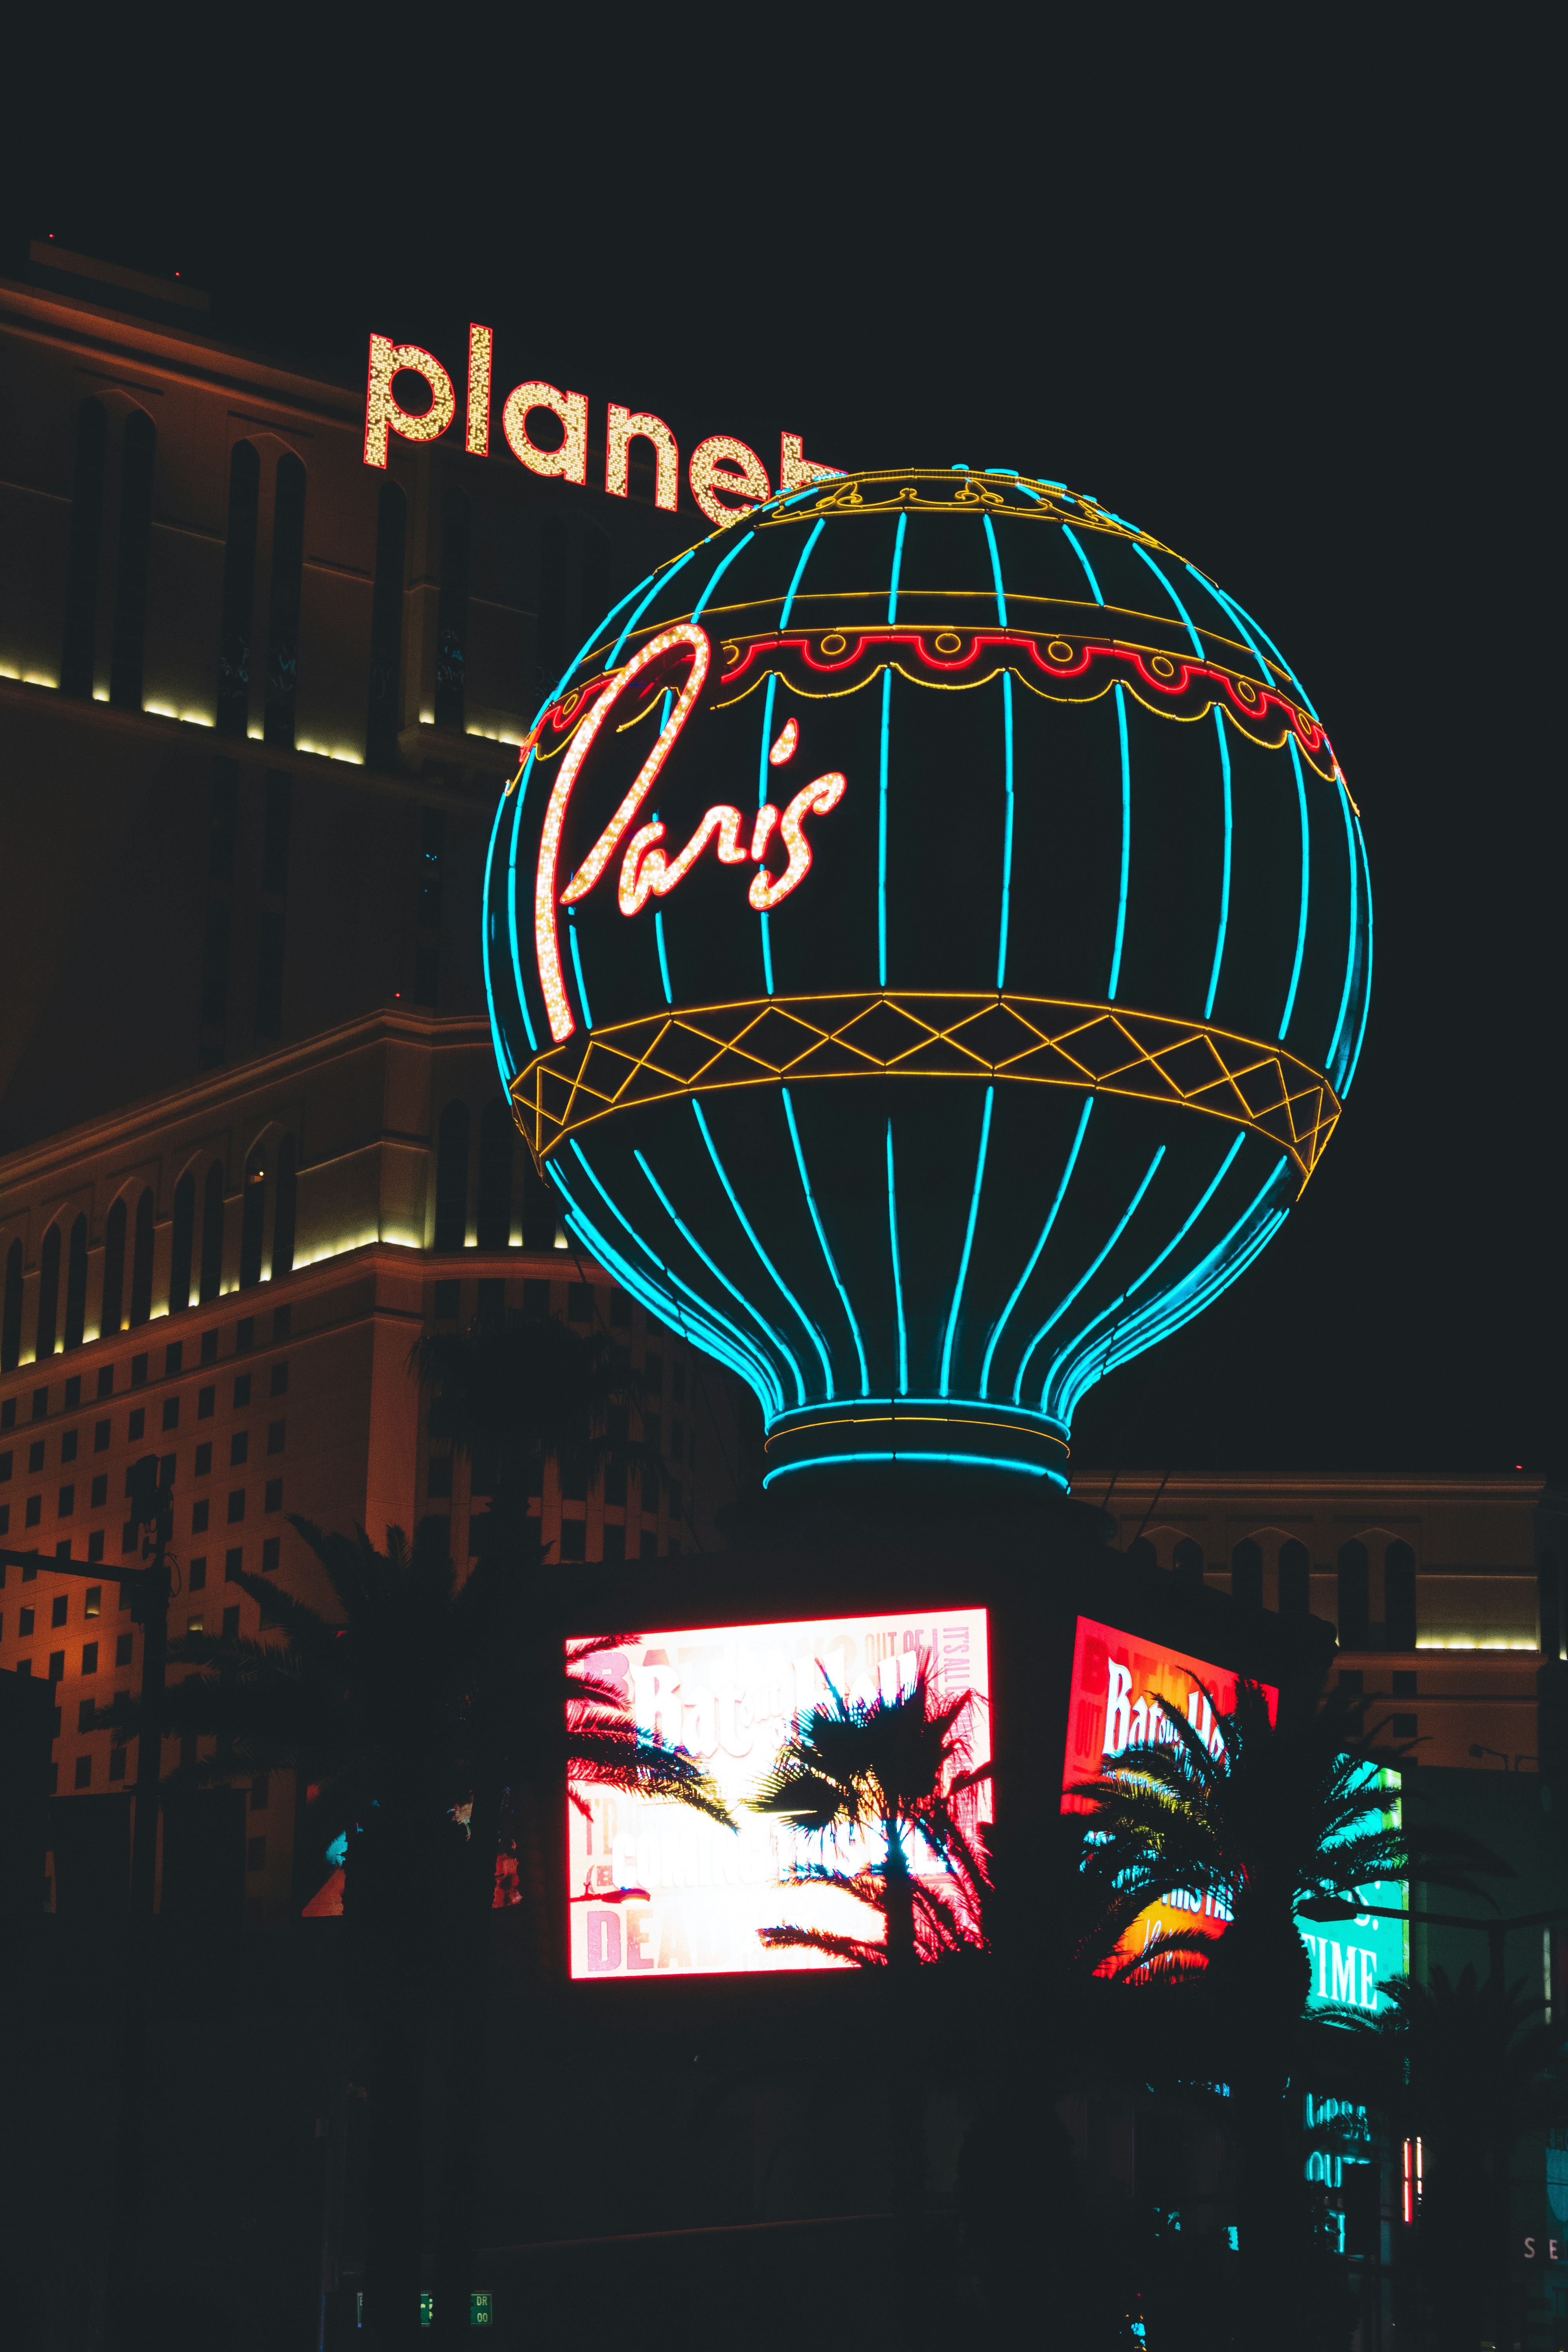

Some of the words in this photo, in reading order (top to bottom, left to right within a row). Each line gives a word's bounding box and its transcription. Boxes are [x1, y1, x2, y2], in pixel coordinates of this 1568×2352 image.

[363, 322, 848, 528] planet
[535, 622, 846, 1043] Paris
[943, 1626, 970, 1654] IT'S
[943, 1658, 970, 1683] ALL
[630, 1663, 753, 1758] Bat
[1075, 1699, 1103, 1756] OUT
[612, 1831, 766, 1890] COMING
[477, 2296, 488, 2306] DR
